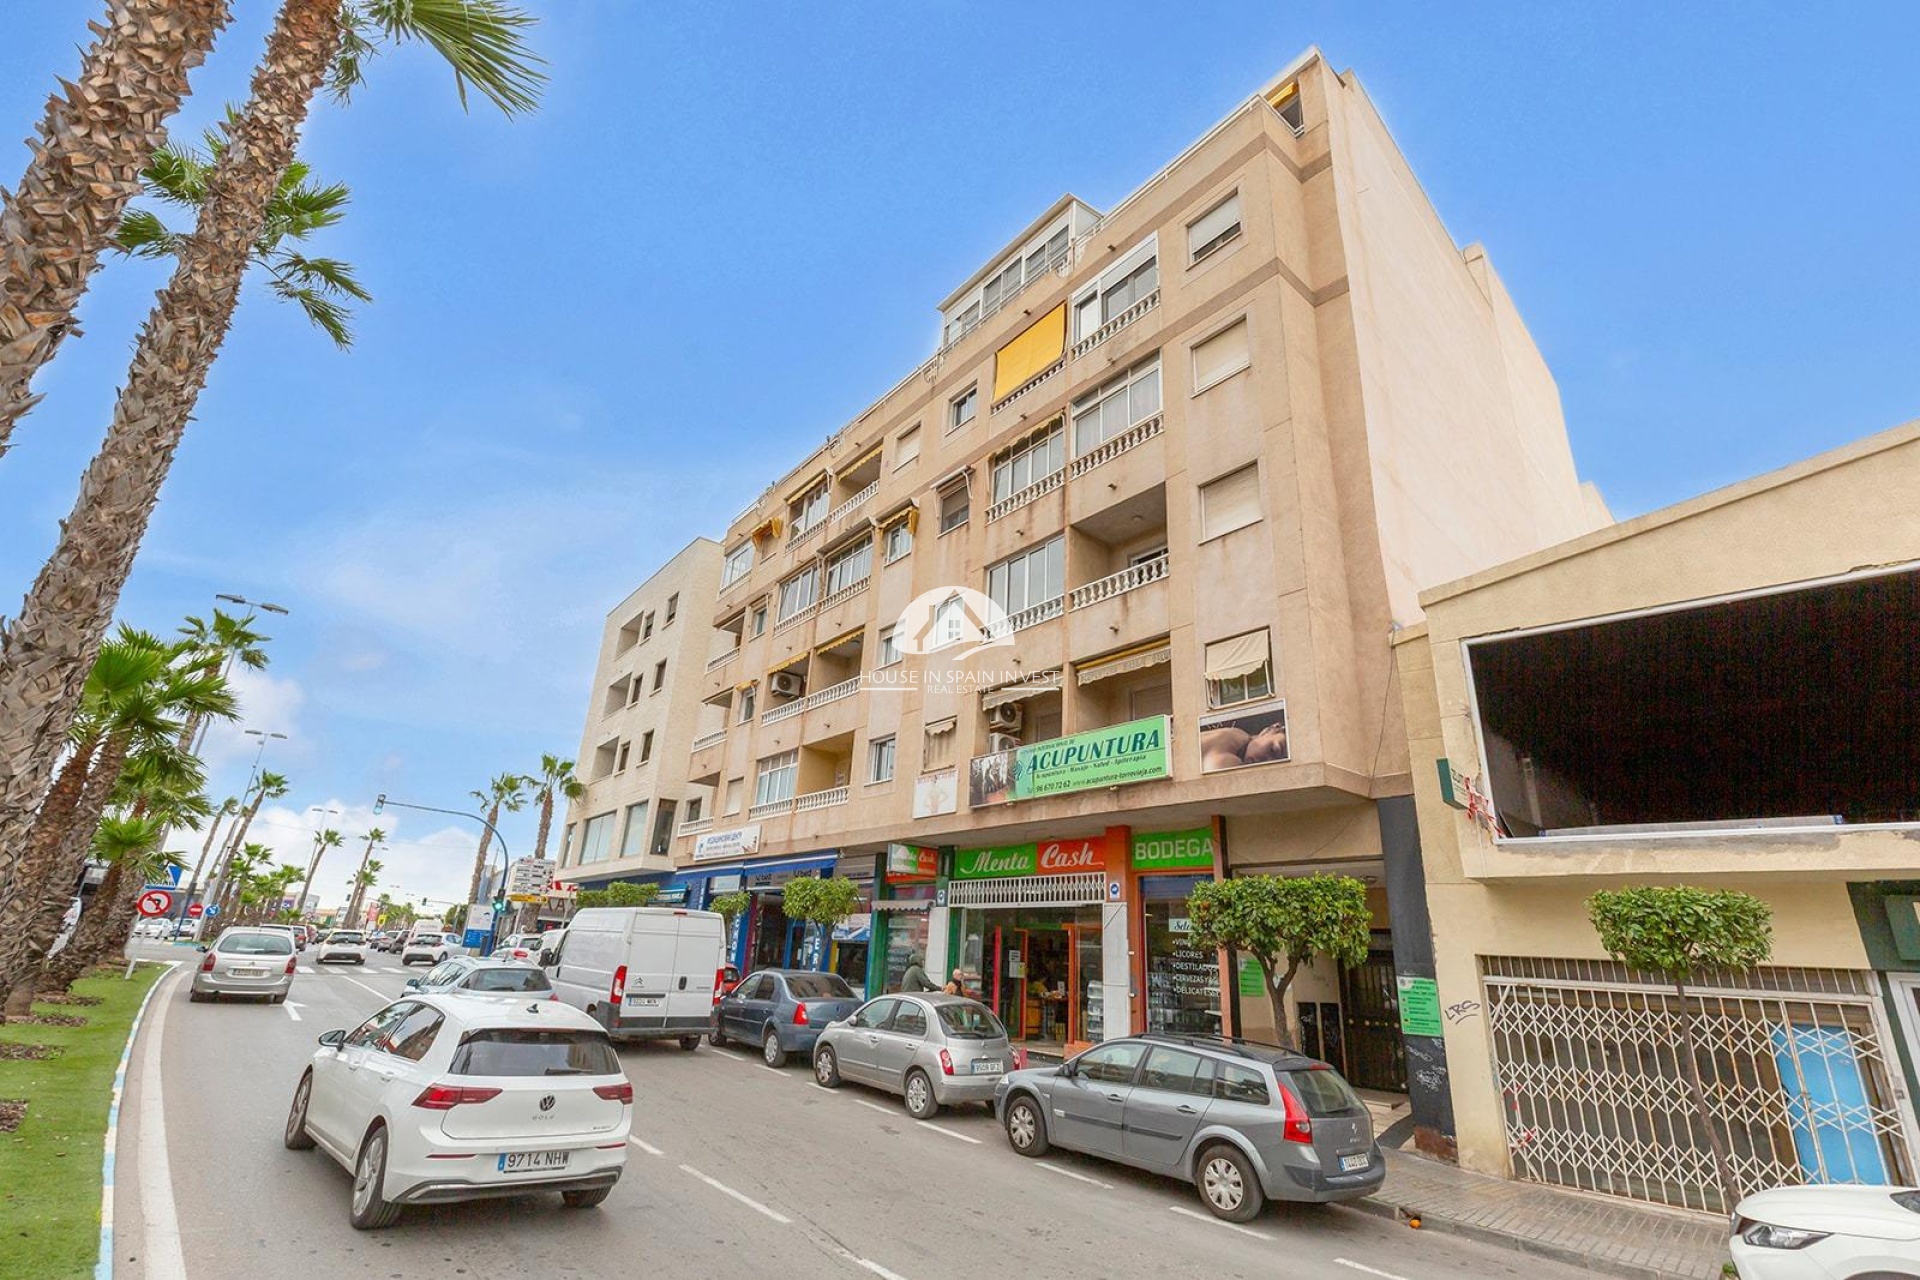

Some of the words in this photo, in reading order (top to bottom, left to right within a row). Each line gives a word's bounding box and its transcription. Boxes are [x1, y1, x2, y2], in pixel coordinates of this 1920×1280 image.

[1027, 729, 1160, 776] ACUPUNTURA
[960, 851, 1032, 874] Menta
[1040, 842, 1105, 868] Cash
[1134, 838, 1214, 860] BODEGA
[1175, 950, 1204, 959] LICORES
[508, 1152, 541, 1168] 9714
[545, 1151, 571, 1165] NHW
